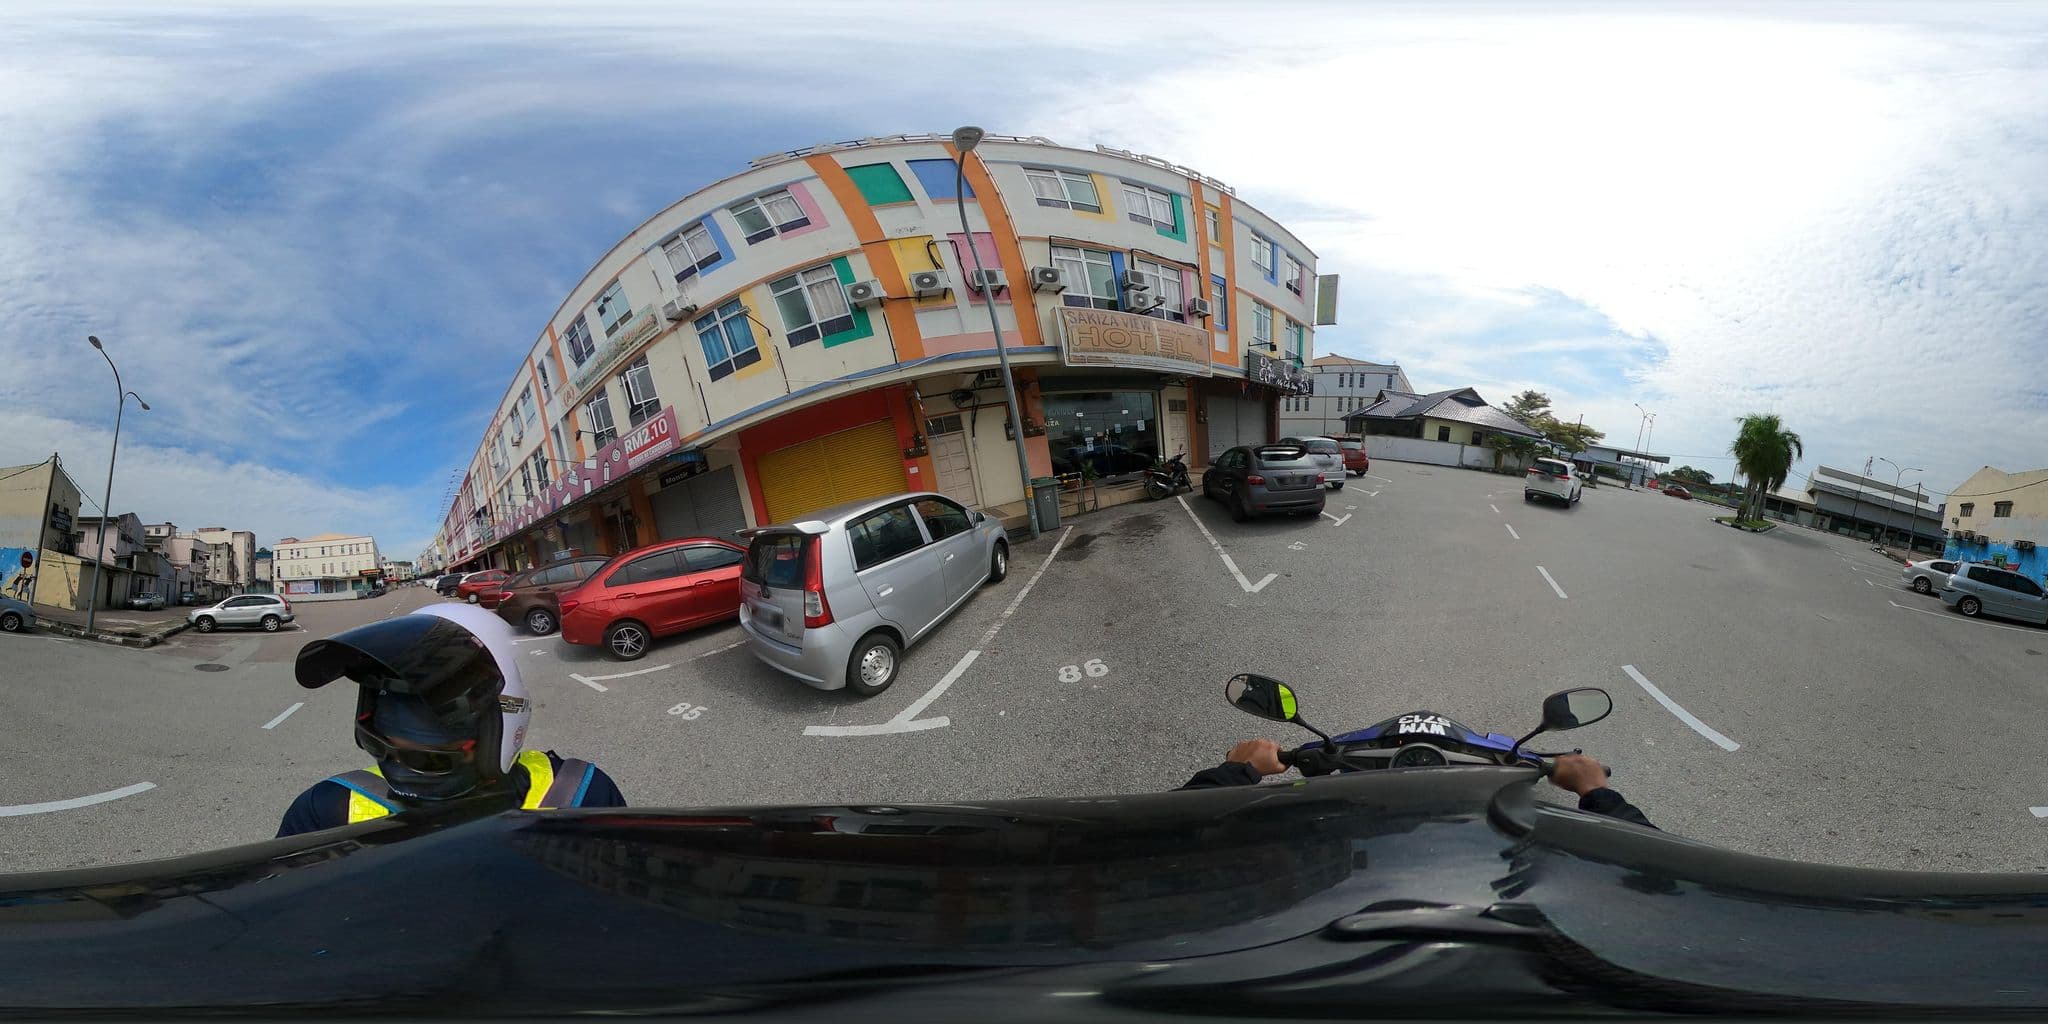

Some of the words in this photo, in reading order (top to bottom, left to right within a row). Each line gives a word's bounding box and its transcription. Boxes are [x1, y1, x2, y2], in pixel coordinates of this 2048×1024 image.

[1066, 310, 1120, 327] SAKIZA
[1120, 316, 1152, 332] VIEW
[1071, 327, 1192, 357] HOTEL
[624, 418, 668, 454] RM2.10
[1058, 658, 1109, 683] 86
[666, 702, 708, 720] 85
[1398, 714, 1451, 728] 5713
[1398, 723, 1446, 736] WYM
